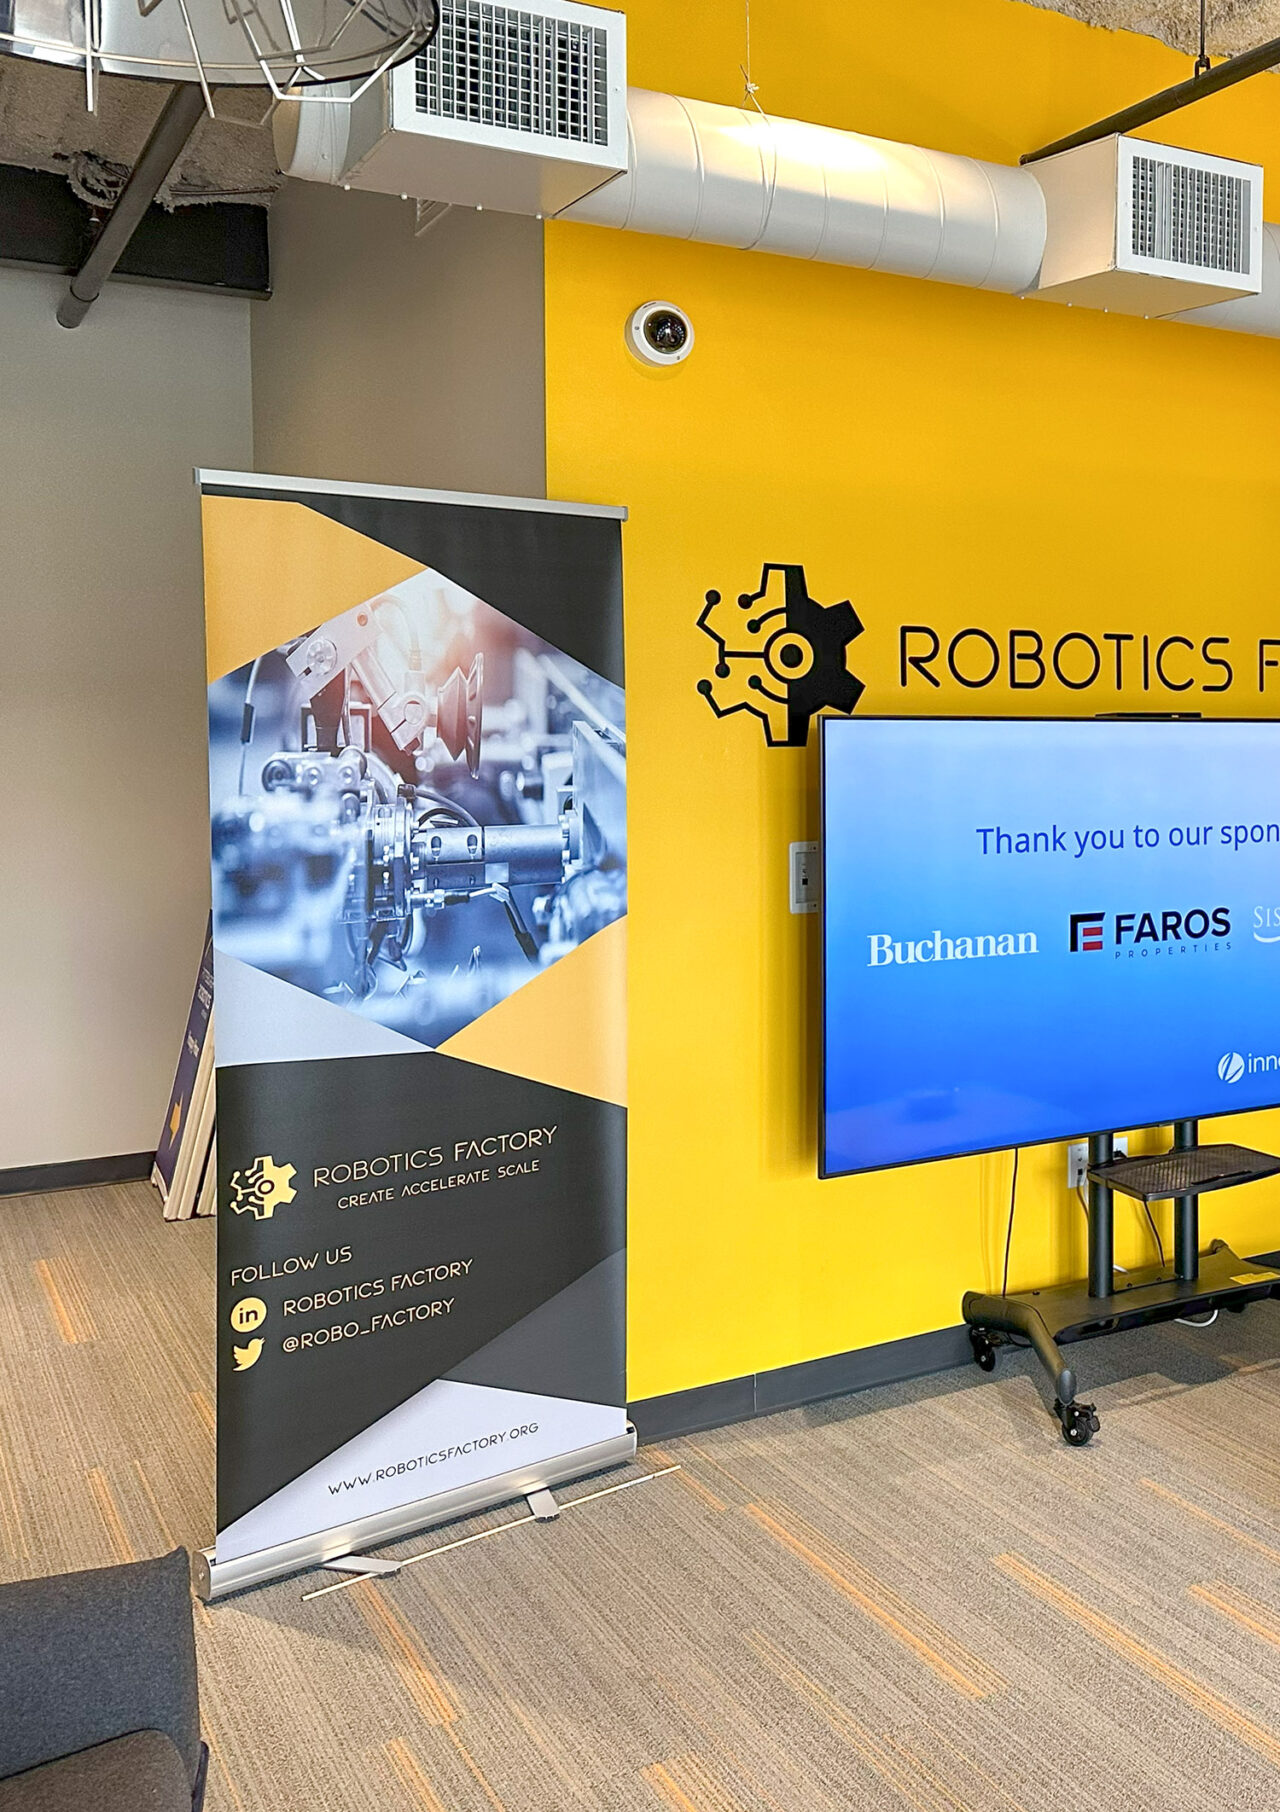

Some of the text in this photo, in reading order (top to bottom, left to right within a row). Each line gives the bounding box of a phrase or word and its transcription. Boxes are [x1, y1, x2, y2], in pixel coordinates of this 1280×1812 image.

[899, 624, 1233, 692] ROBOTICS
[976, 825, 1066, 854] Thank
[1074, 830, 1123, 858] you
[1133, 825, 1159, 848] to
[1169, 826, 1213, 846] our
[867, 930, 1039, 966] Buchanan
[1115, 907, 1231, 945] FAROS
[1115, 941, 1232, 960] PROPERTIES
[313, 1125, 558, 1188] ROBOTICS FACTORY
[337, 1159, 540, 1208] CREATE ACCELERATE SCALE
[230, 1246, 351, 1285] FOLLOW US
[282, 1259, 472, 1318] ROBOTICS FACTORY
[238, 1307, 260, 1326] in
[282, 1297, 456, 1353] @ROBO_FACTORY
[327, 1422, 540, 1496] WWW.ROBOTICSFACTORY.ORG
